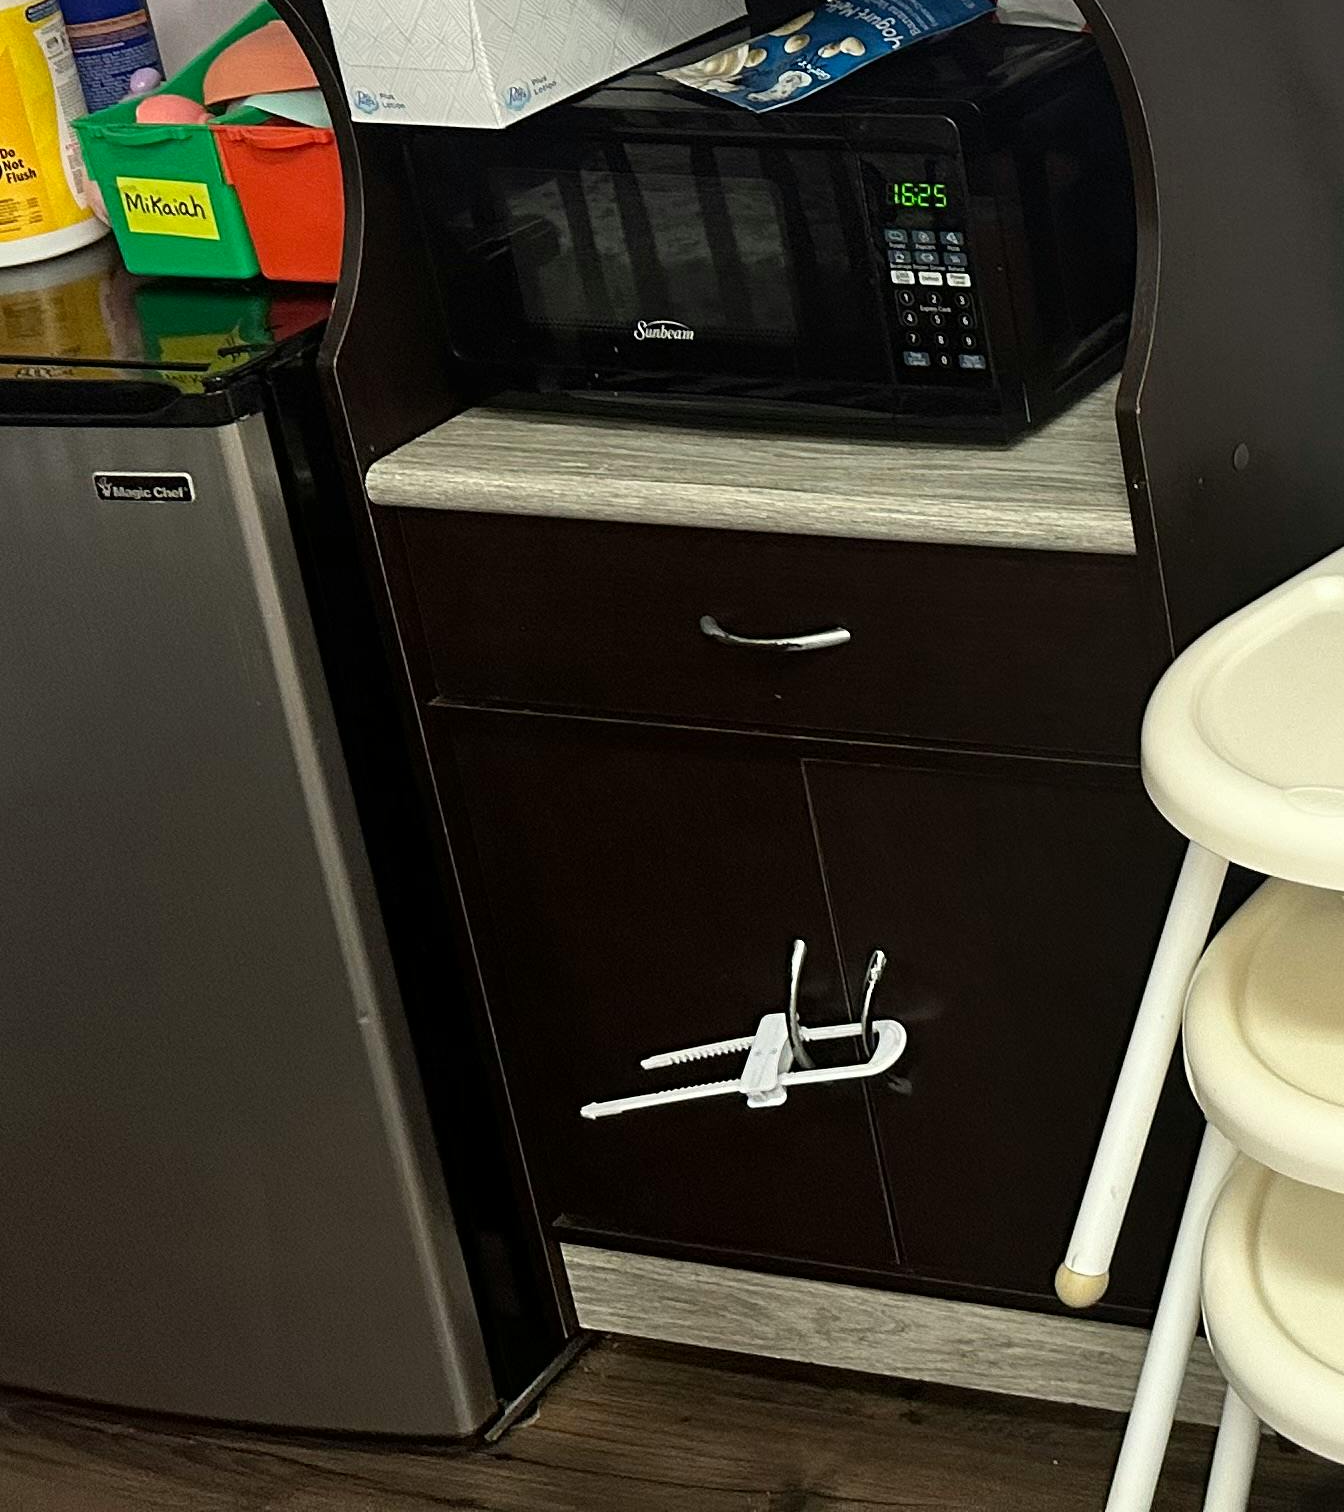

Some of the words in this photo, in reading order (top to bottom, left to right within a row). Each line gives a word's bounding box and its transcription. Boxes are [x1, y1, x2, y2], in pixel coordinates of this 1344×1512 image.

[0, 148, 16, 160] Do
[3, 158, 25, 171] Not
[6, 168, 37, 184] Flush
[633, 320, 695, 341] Sunbeam
[113, 487, 152, 500] Magic
[153, 486, 184, 499] Chef
